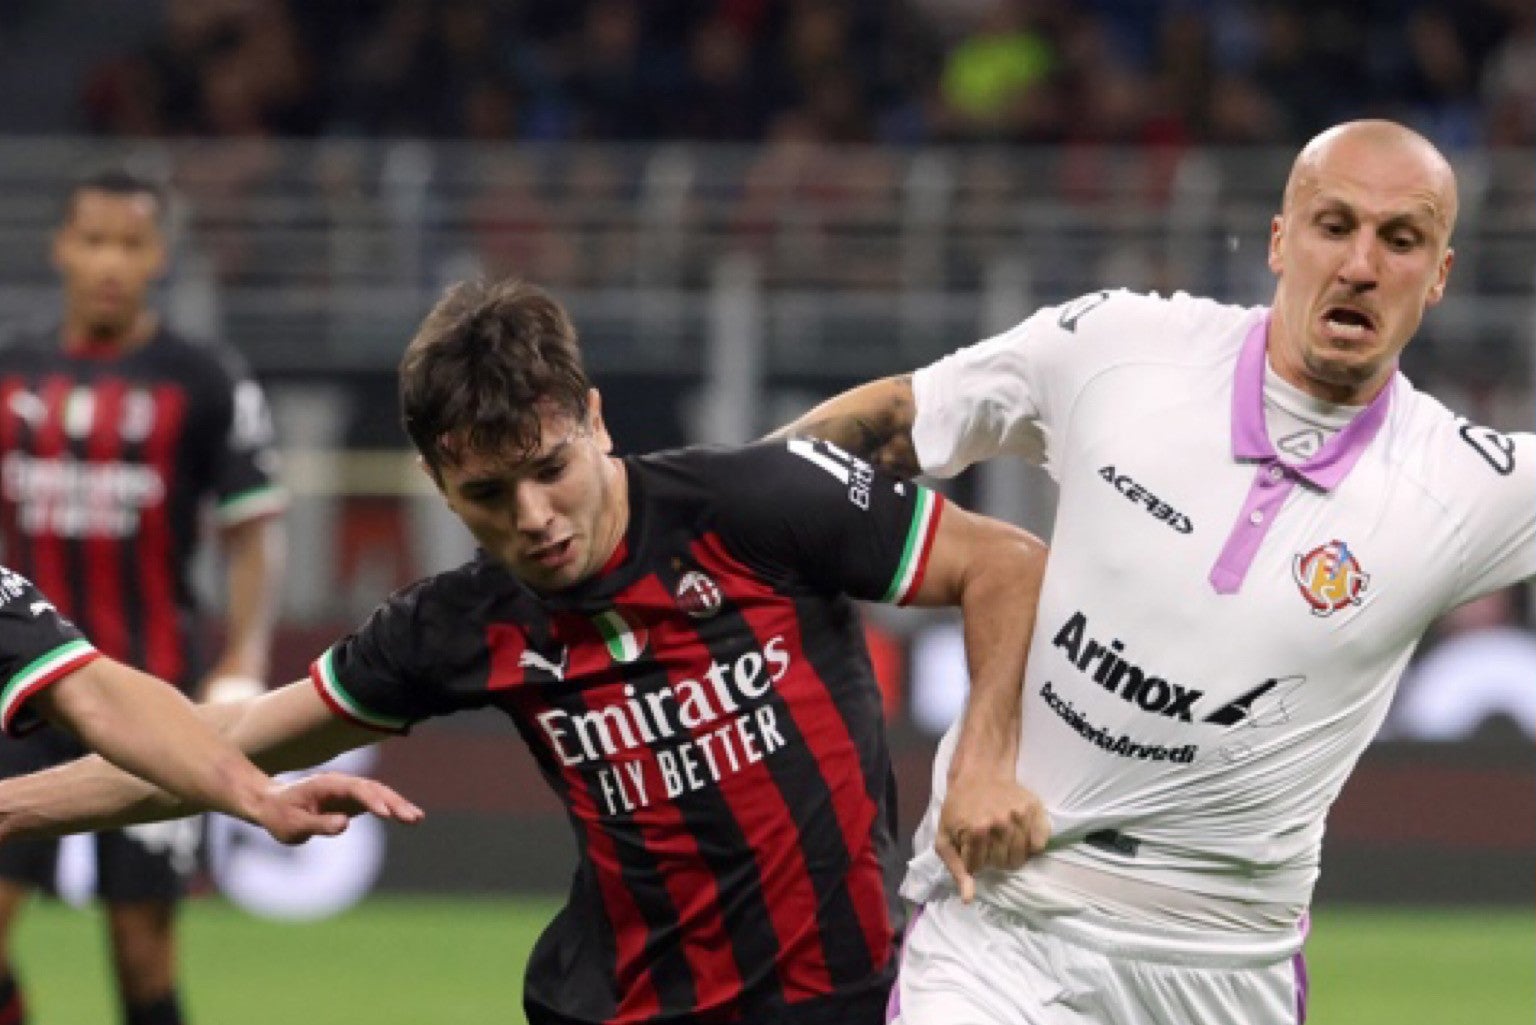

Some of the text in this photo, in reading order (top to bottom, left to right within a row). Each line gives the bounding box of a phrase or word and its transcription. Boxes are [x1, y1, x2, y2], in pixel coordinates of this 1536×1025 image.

[536, 634, 790, 766] Emirates
[1052, 611, 1205, 723] Arinox
[598, 704, 786, 816] FLY BETTER
